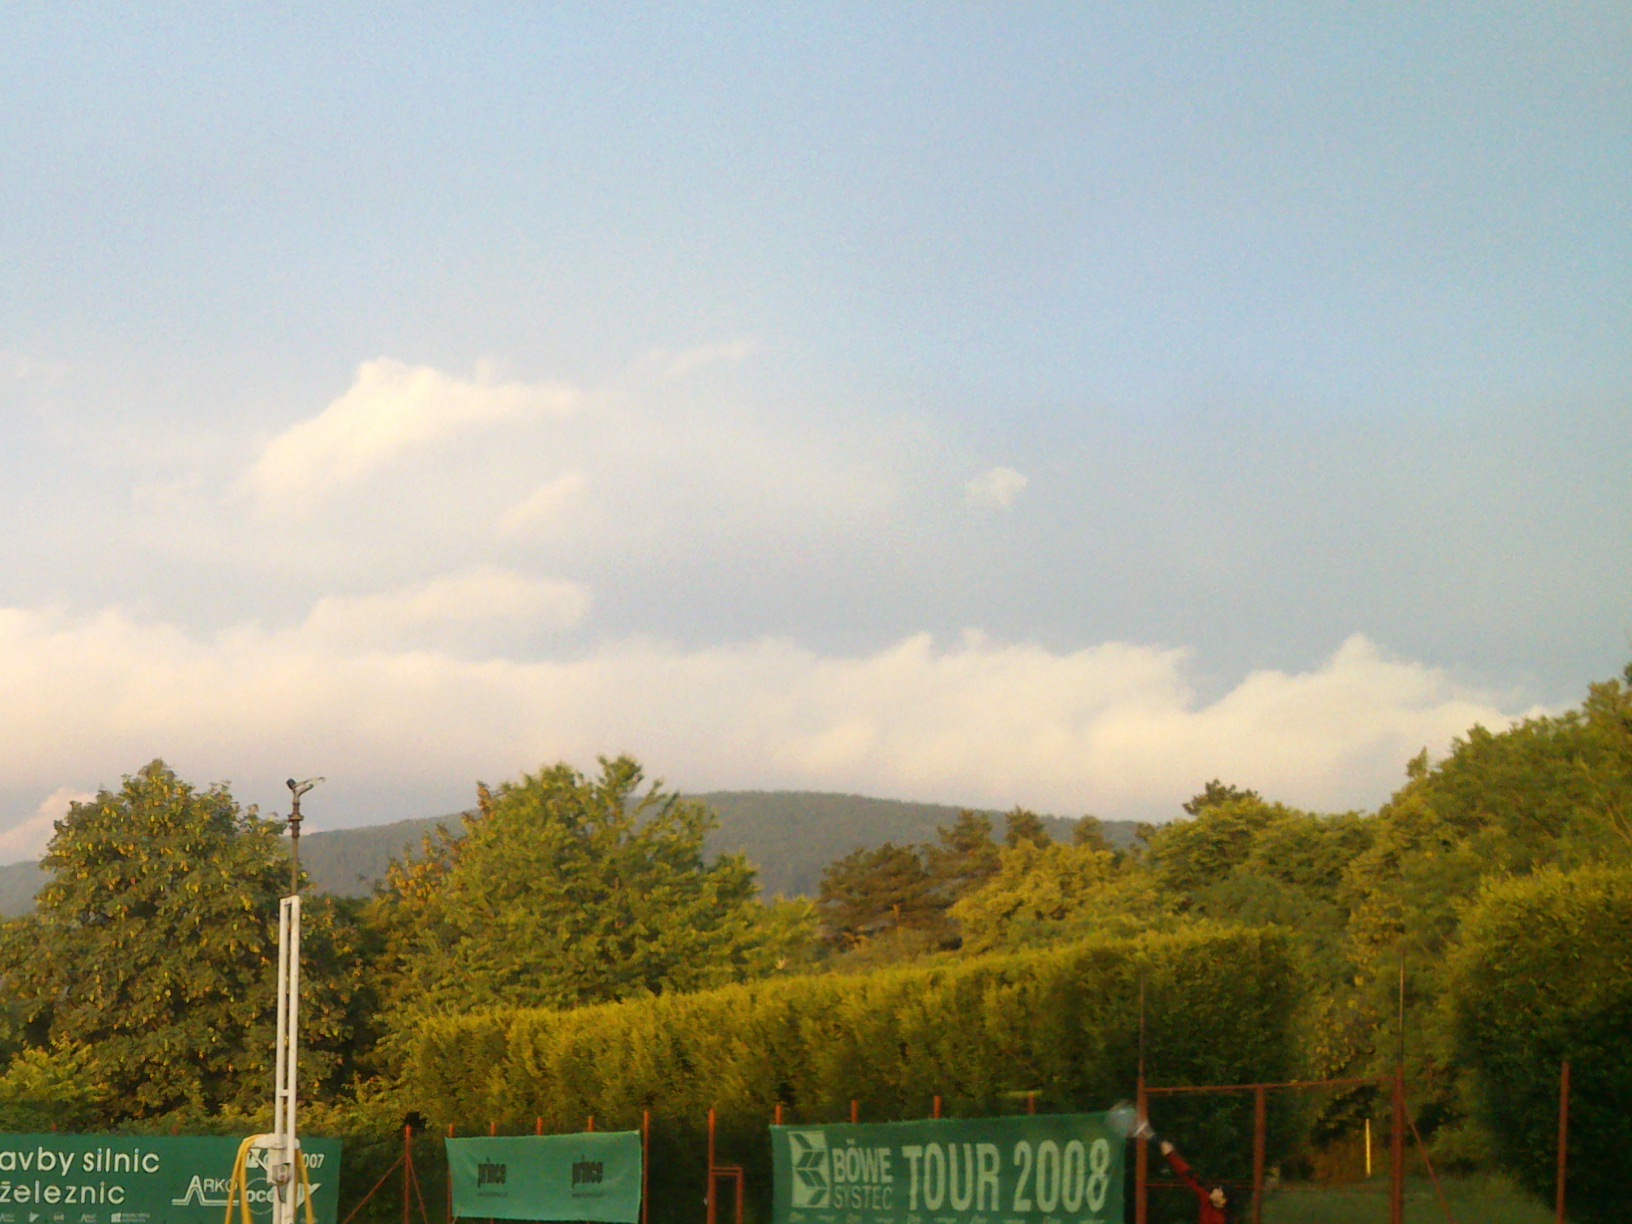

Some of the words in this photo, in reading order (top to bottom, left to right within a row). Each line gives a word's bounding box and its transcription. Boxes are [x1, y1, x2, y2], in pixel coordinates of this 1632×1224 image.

[83, 1148, 160, 1174] silnic
[901, 1142, 1000, 1212] TOUR
[1013, 1138, 1110, 1213] 2008
[0, 1180, 126, 1205] železnic
